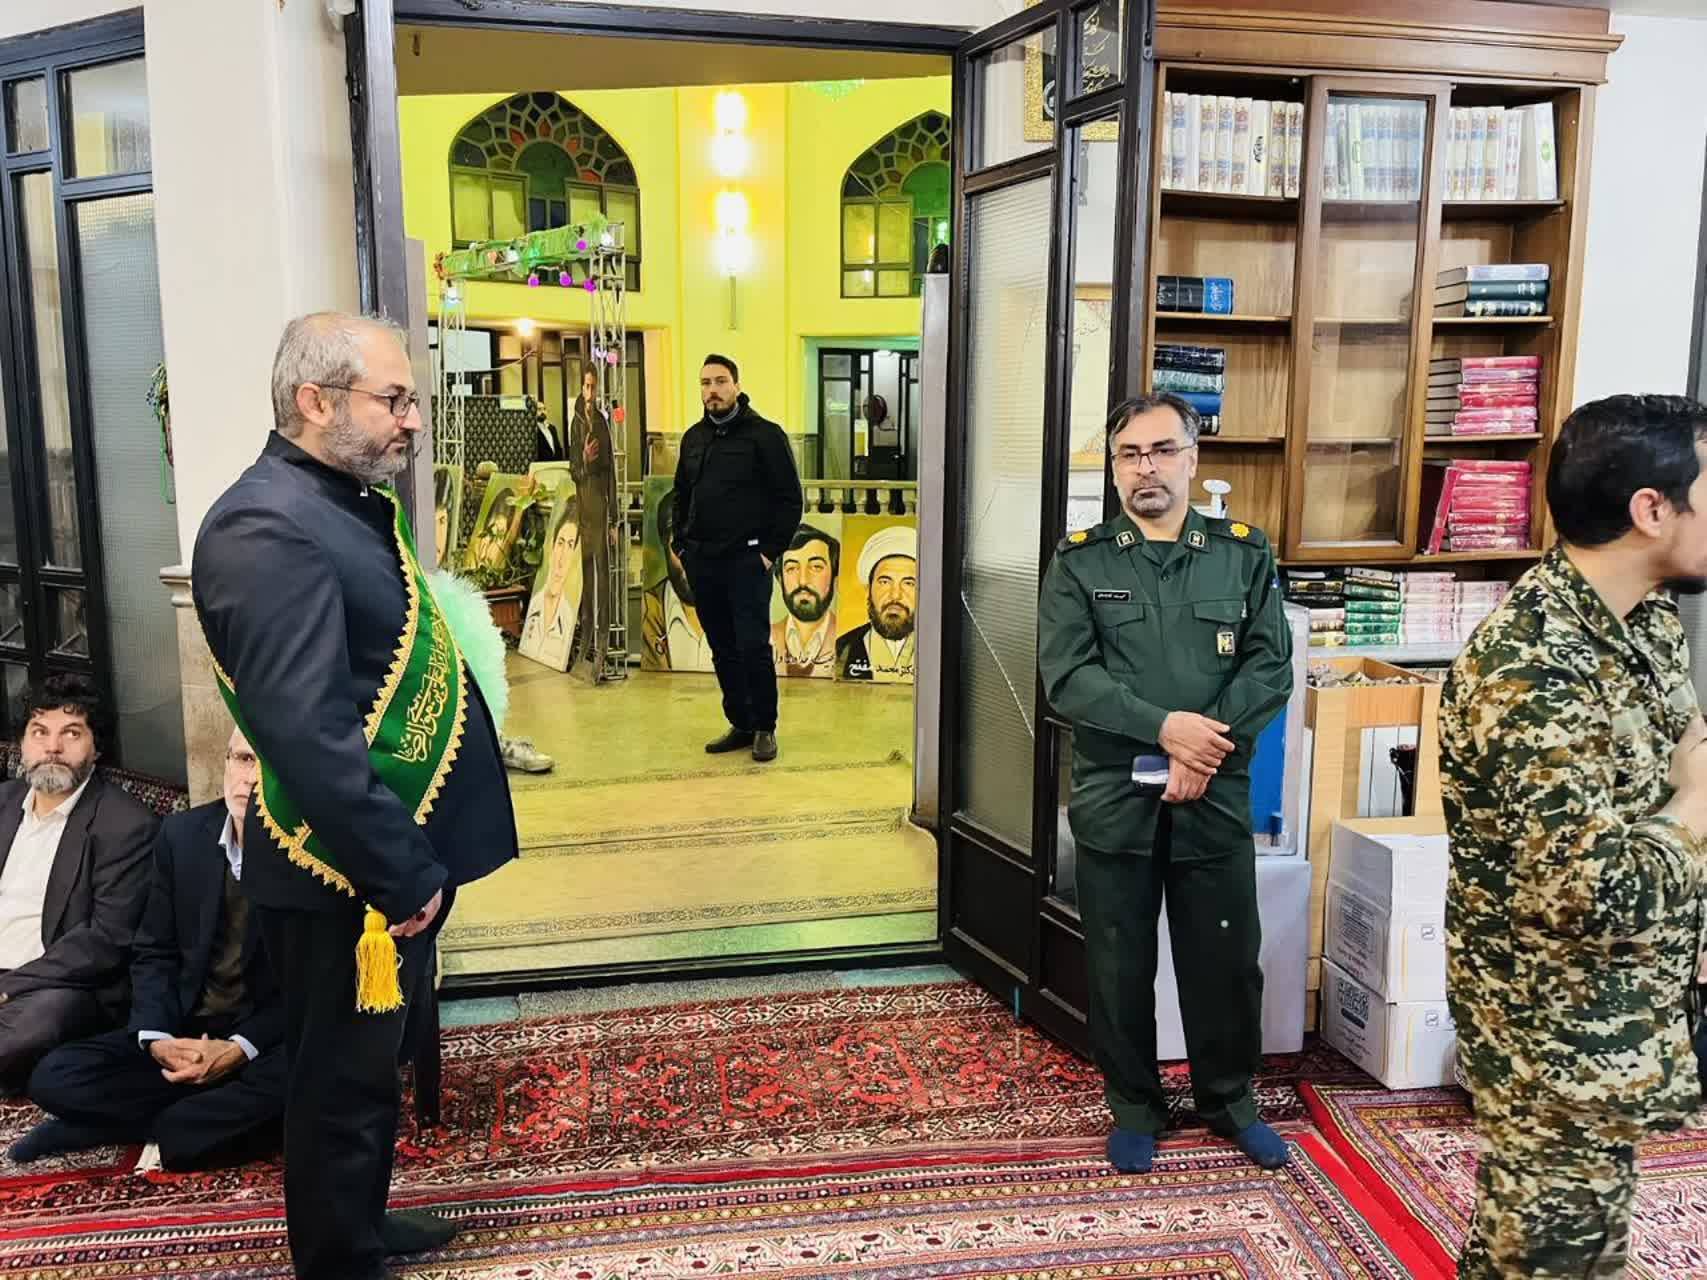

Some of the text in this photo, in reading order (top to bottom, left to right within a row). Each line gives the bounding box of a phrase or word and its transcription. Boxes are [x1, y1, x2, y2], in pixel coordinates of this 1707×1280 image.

[848, 659, 874, 677] مفتح
[876, 664, 899, 673] محمد
[392, 721, 433, 764] الرضا
